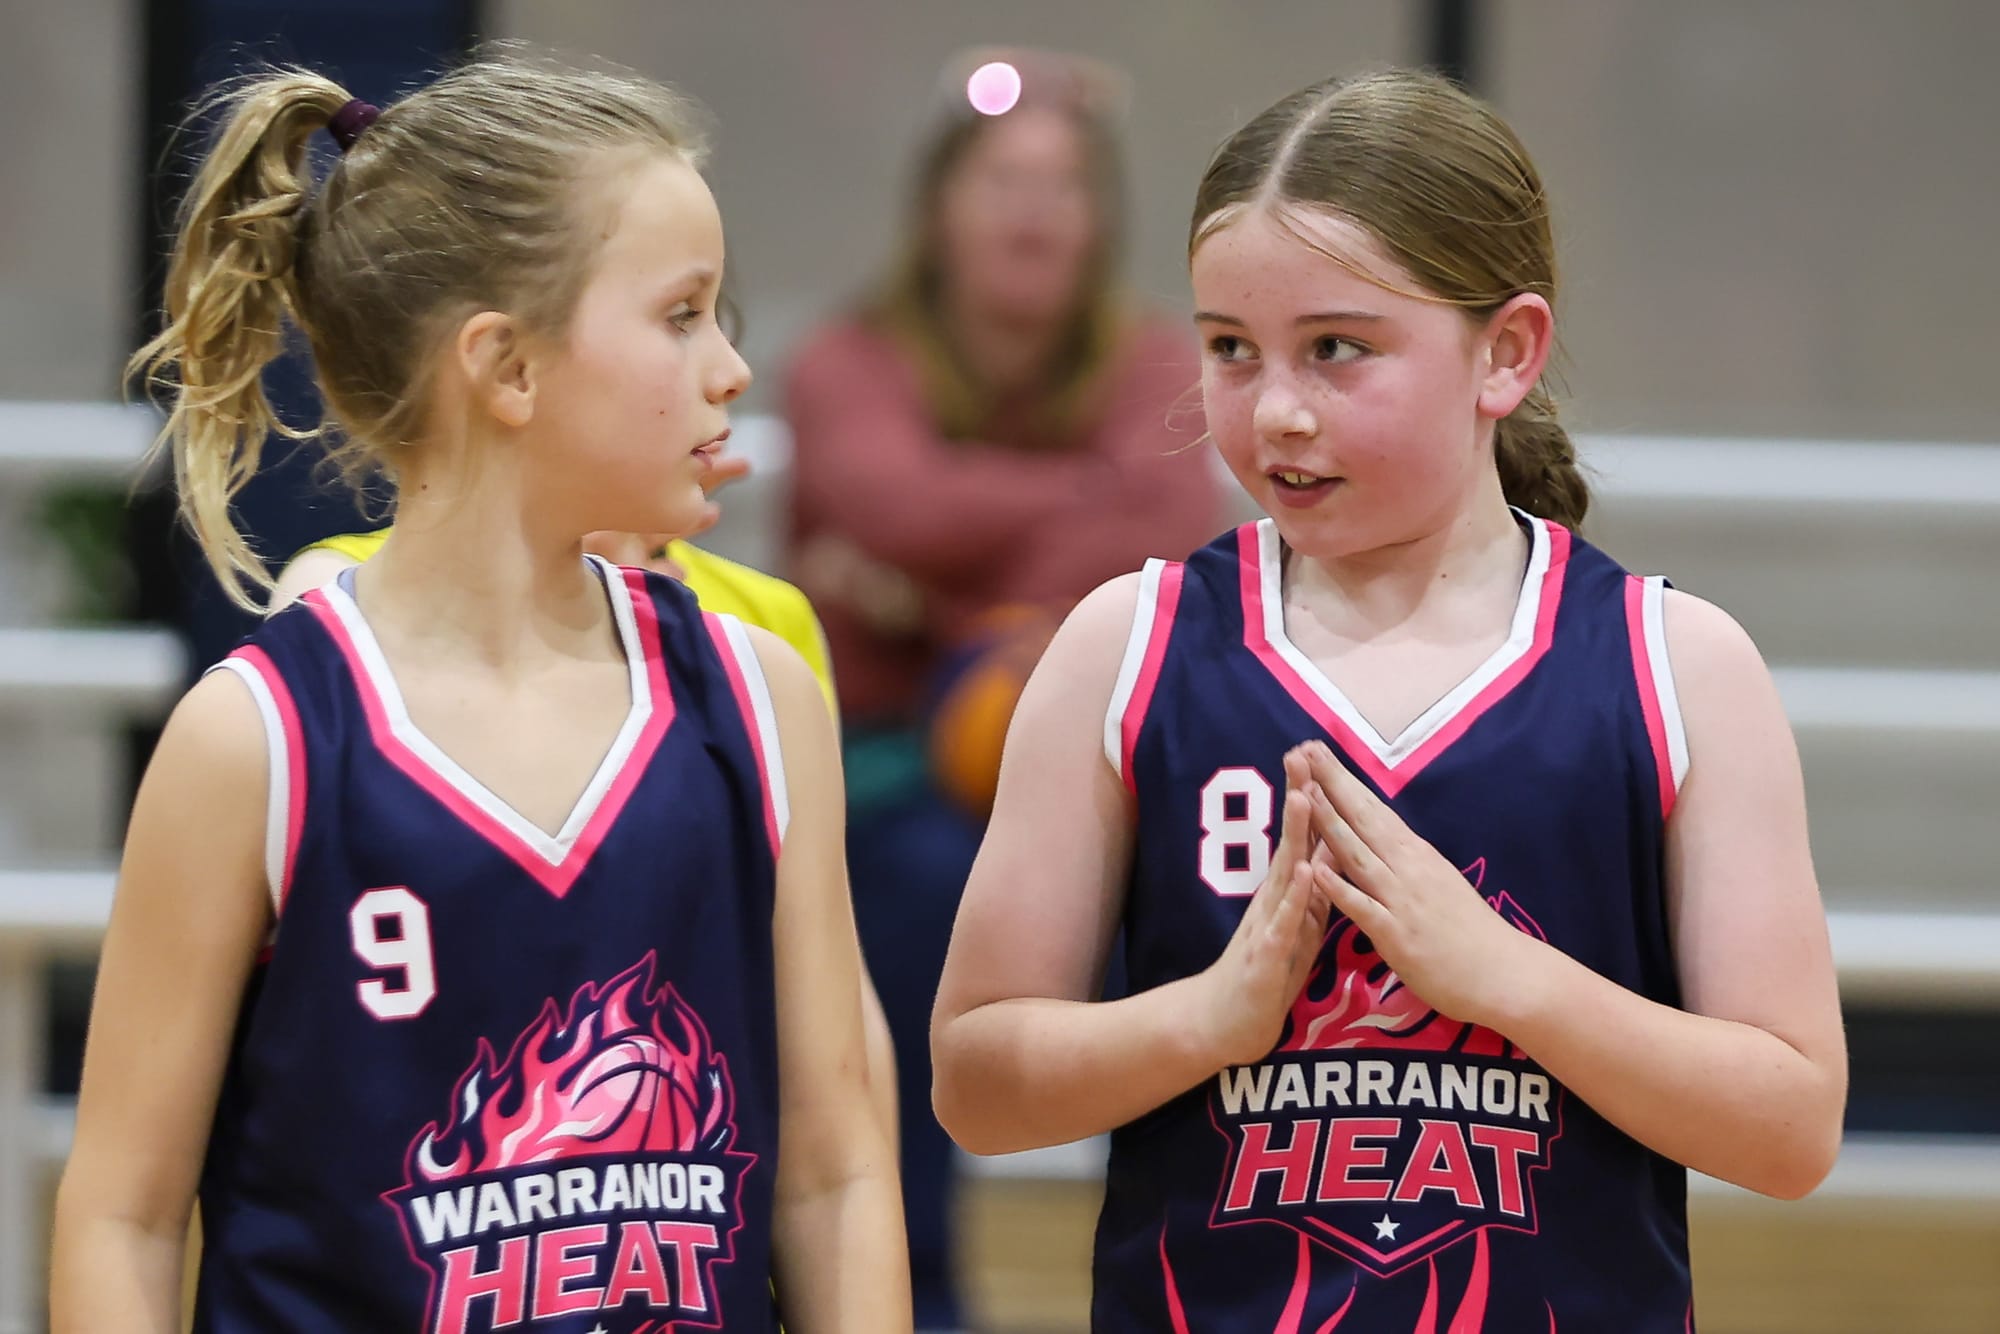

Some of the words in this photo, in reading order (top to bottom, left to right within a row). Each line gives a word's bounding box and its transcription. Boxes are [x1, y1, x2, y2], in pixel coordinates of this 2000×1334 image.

[1198, 766, 1274, 896] 8
[349, 886, 437, 1022] 9
[1219, 1060, 1550, 1122] WARRANOR
[411, 1162, 726, 1245] WARRANOR
[1223, 1117, 1540, 1218] HEAT
[434, 1220, 719, 1334] HEAT
